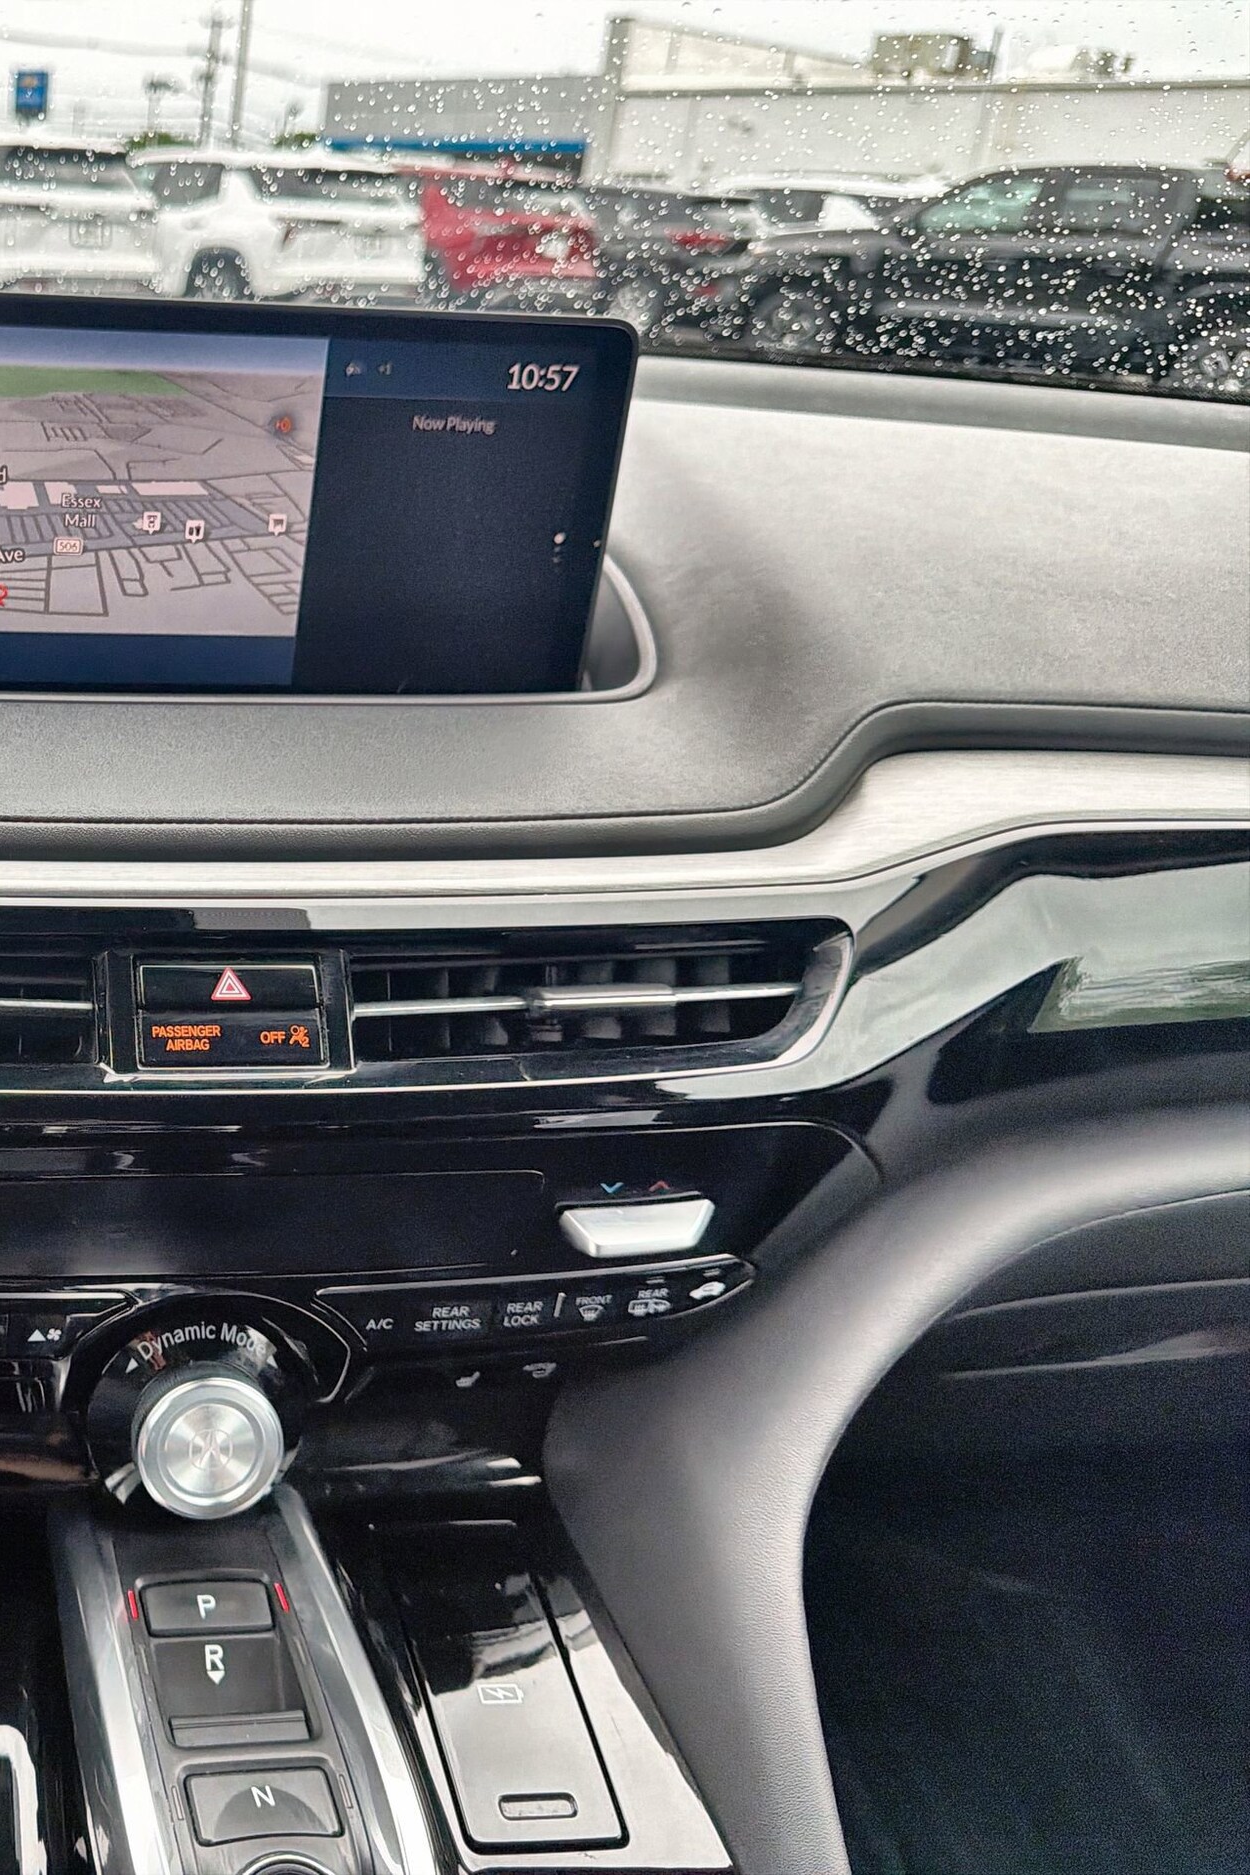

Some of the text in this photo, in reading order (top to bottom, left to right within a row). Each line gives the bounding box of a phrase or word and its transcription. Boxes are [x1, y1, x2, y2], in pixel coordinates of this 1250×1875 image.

[507, 363, 580, 392] 10:57
[412, 415, 496, 435] Now Playing
[61, 493, 102, 508] Essex
[64, 513, 96, 528] Mall
[59, 541, 78, 551] 506
[151, 1025, 221, 1038] PASSENGER
[260, 1031, 286, 1044] OFF
[166, 1038, 210, 1051] AIRBAG
[576, 1294, 612, 1306] FRONT
[638, 1288, 669, 1299] REAR
[432, 1305, 470, 1318] REAR
[506, 1301, 543, 1314] REAR
[366, 1318, 393, 1330] A/C
[414, 1318, 481, 1332] SETTINGS
[503, 1314, 539, 1327] LOCK
[137, 1321, 216, 1361] Dynamic
[196, 1594, 217, 1619] P
[204, 1644, 225, 1671] R
[250, 1785, 276, 1808] N
